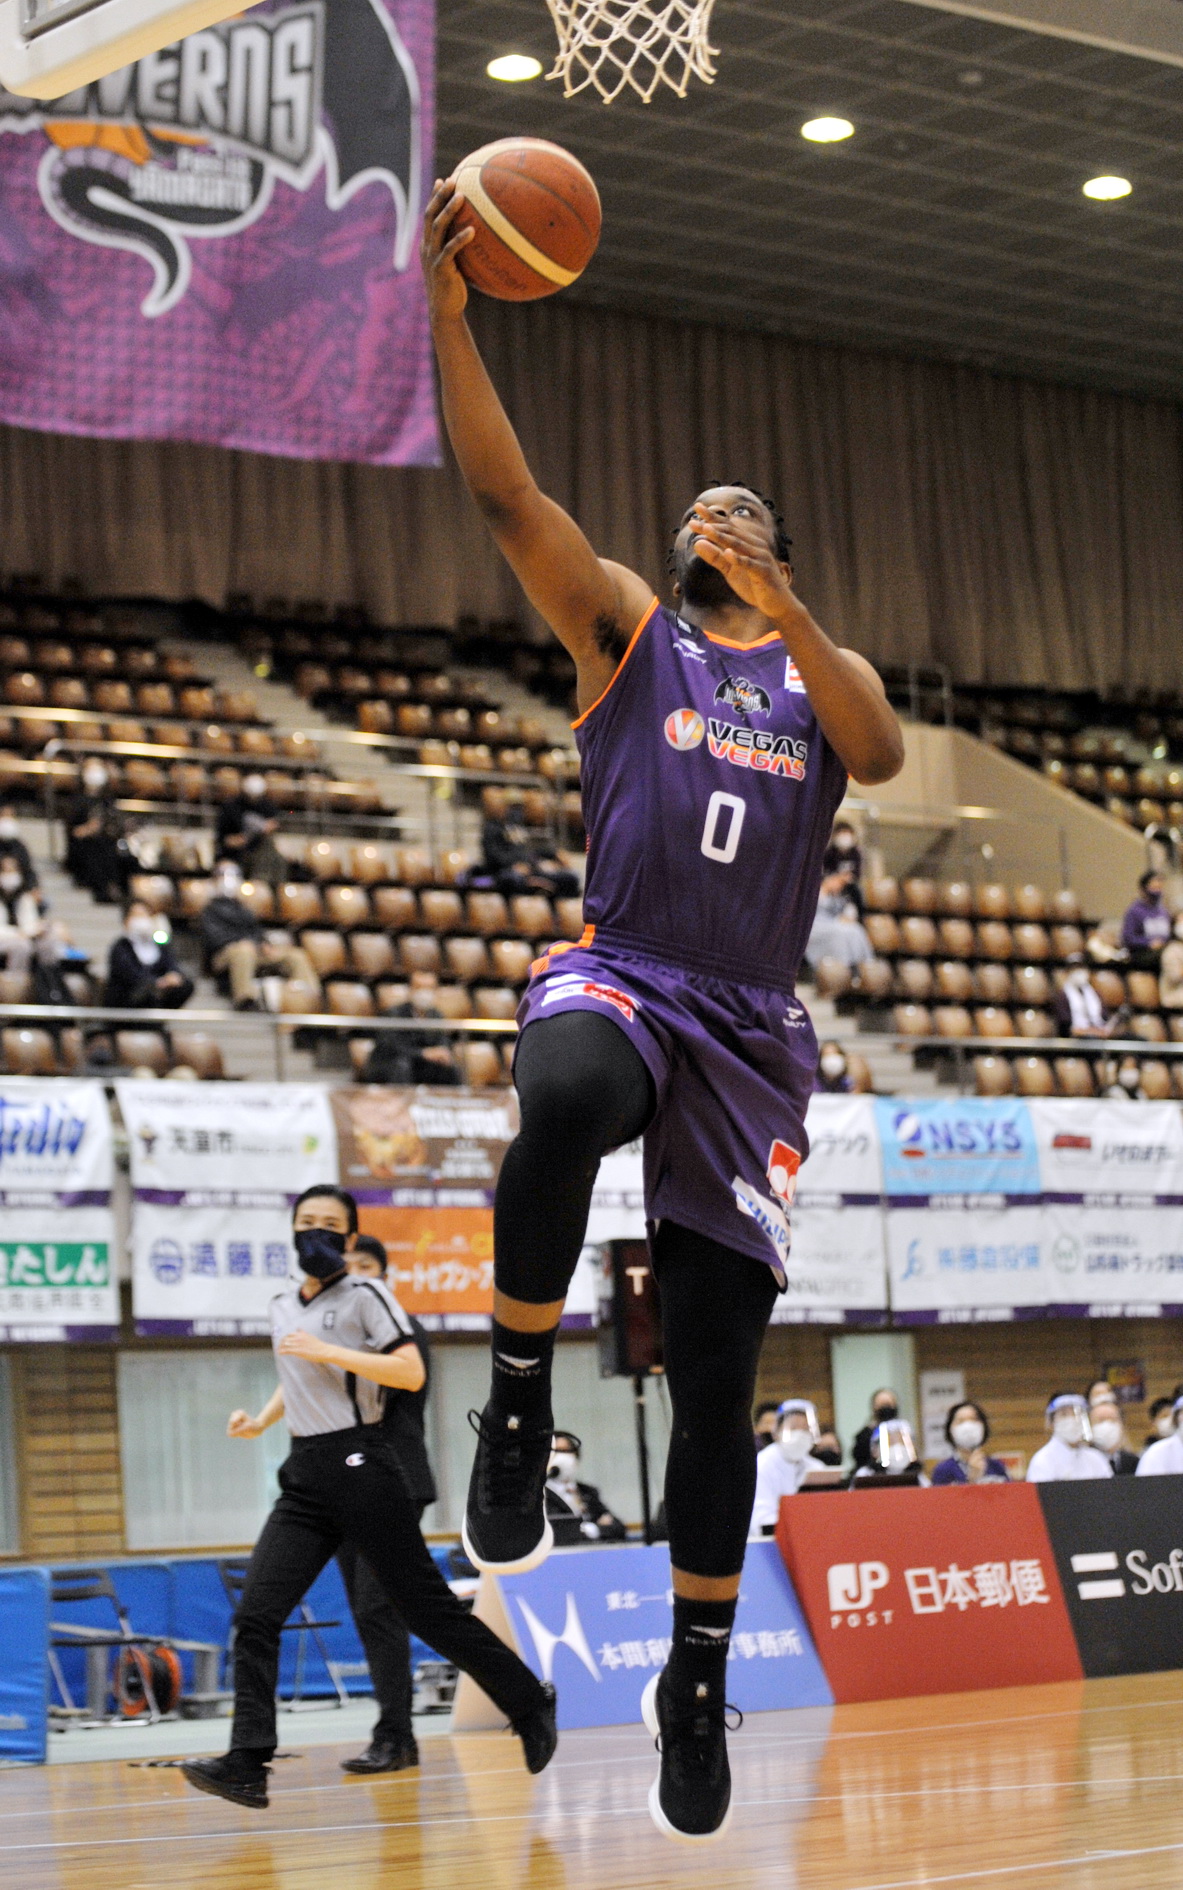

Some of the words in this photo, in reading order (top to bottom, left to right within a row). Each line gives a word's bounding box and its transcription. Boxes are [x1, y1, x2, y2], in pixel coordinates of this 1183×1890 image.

[0, 16, 314, 160] VERNS
[707, 732, 806, 781] VEGAS
[708, 717, 808, 762] VEGAS
[701, 790, 746, 864] 0
[928, 1119, 1021, 1152] NSYS
[0, 1245, 107, 1285] たしん
[903, 1558, 1050, 1615] 日本郵便
[830, 1610, 894, 1630] POST
